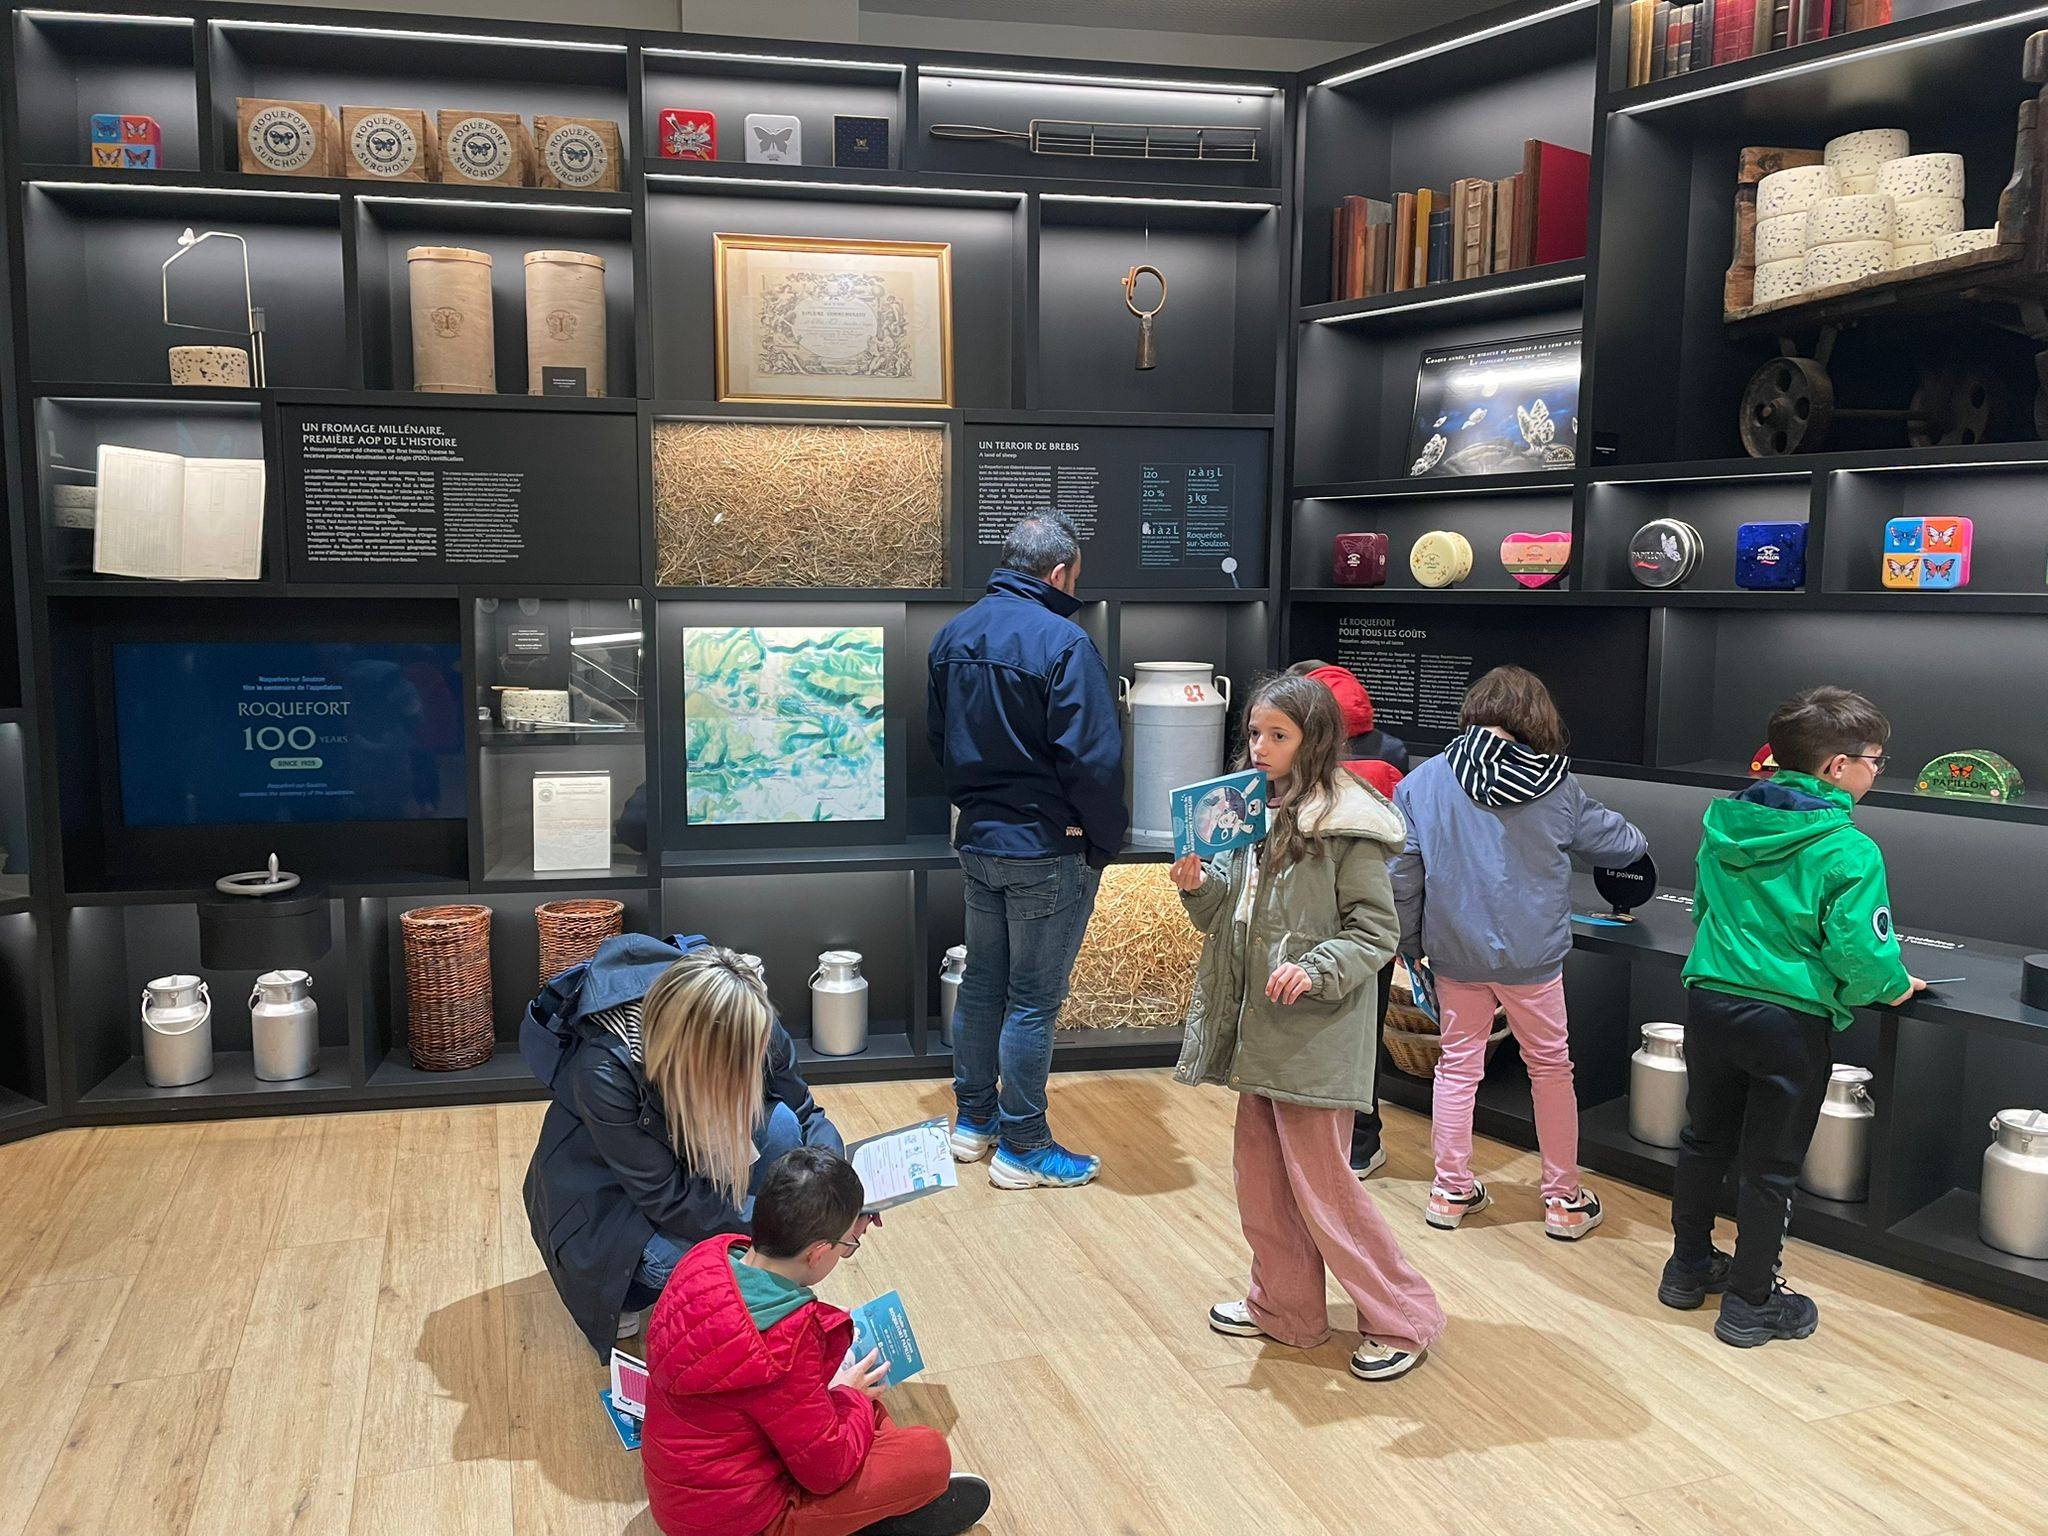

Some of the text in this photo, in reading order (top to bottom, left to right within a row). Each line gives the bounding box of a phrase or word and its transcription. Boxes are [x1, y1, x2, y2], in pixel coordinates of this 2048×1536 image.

[254, 111, 311, 136] ROQUEFORT
[355, 117, 412, 141] ROQUEFORT
[452, 122, 507, 146] ROQUEFORT
[550, 128, 604, 154] ROQUEFORT
[255, 145, 308, 168] SURCHOIX
[357, 151, 410, 173] SURCHOIX
[454, 156, 505, 177] SURCHOIX
[550, 160, 601, 183] SURCHOIX
[302, 423, 445, 436] UN FROMAGE MILLÉNAIRE,
[302, 434, 458, 447] PREMIÈRE AOP DE L'HISTOIRE
[979, 442, 1080, 450] UN TERROIR DE BREBIS
[1198, 467, 1204, 476] à
[1206, 469, 1214, 478] 13
[1217, 468, 1223, 476] L
[1187, 493, 1208, 504] 3 kg
[1158, 526, 1164, 534] à
[1174, 526, 1180, 534] L
[1186, 532, 1226, 540] Roquefort-
[1632, 551, 1666, 560] PAPILLON
[1350, 618, 1395, 627] ROQUEFORT
[1398, 629, 1426, 638] GOÛTS
[1184, 684, 1205, 702] 27
[238, 702, 351, 719] ROQUEFORT
[242, 726, 348, 750] 100 YEARS
[1932, 778, 1988, 790] PAPILLON
[1616, 872, 1644, 881] poivron
